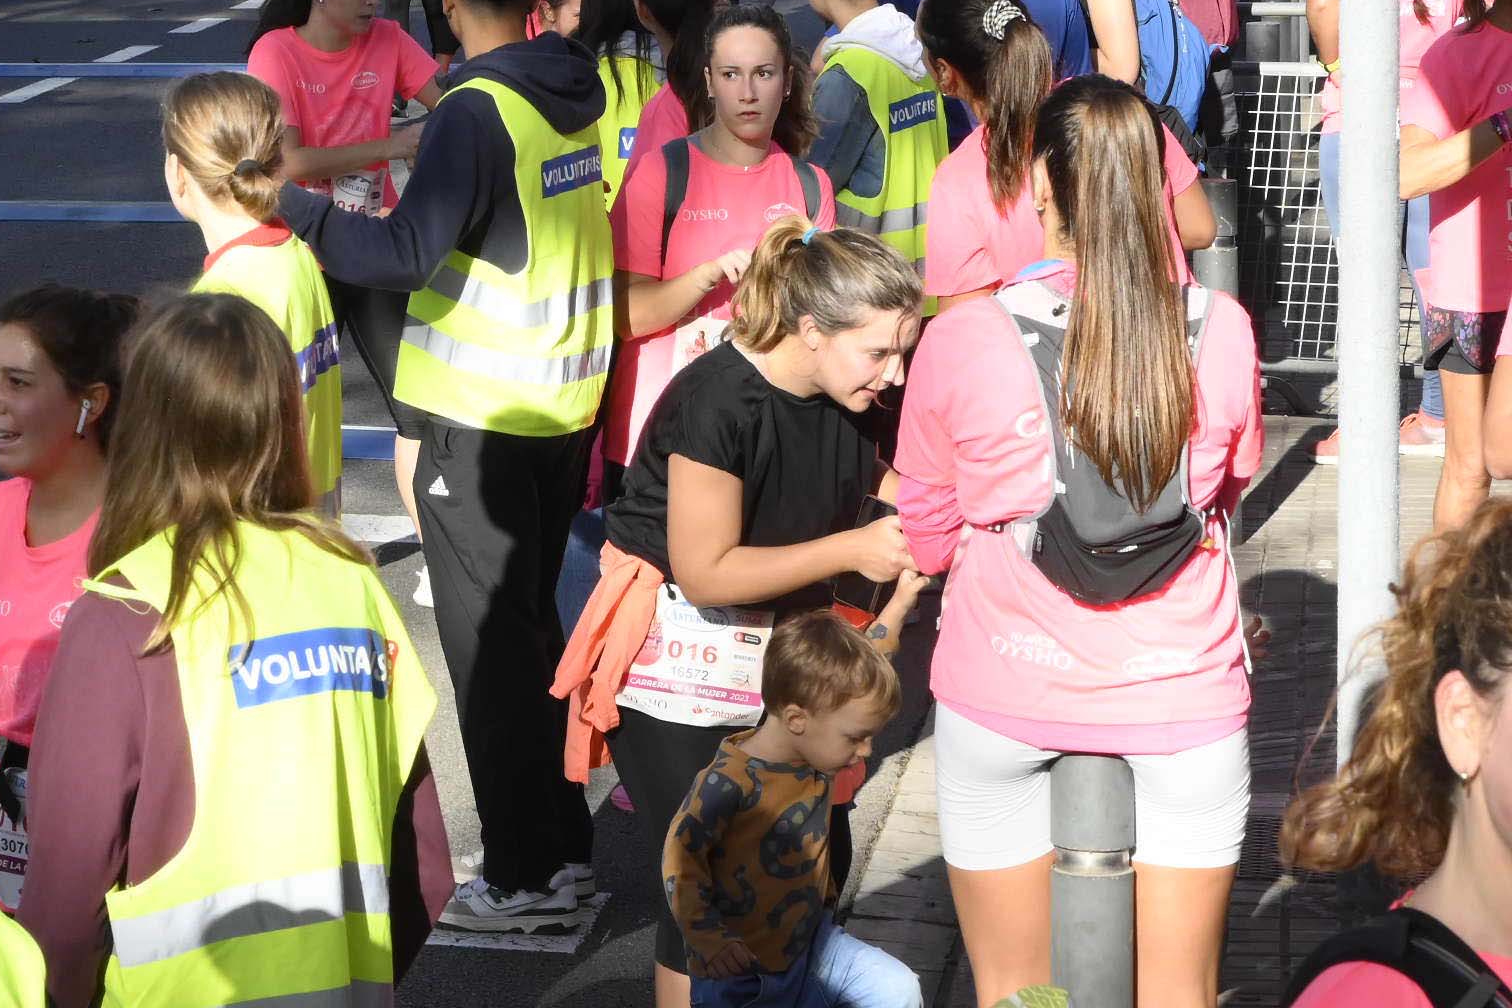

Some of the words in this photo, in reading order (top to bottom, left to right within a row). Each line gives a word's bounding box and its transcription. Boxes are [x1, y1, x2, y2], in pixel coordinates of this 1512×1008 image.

[668, 640, 718, 664] 016
[991, 635, 1075, 671] OYSHO
[239, 644, 386, 691] VOLUNTAS
[672, 666, 709, 682] 16572
[630, 677, 668, 689] CARRERA
[698, 687, 728, 699] MUJER
[729, 693, 750, 702] 2023
[9, 861, 21, 870] LA
